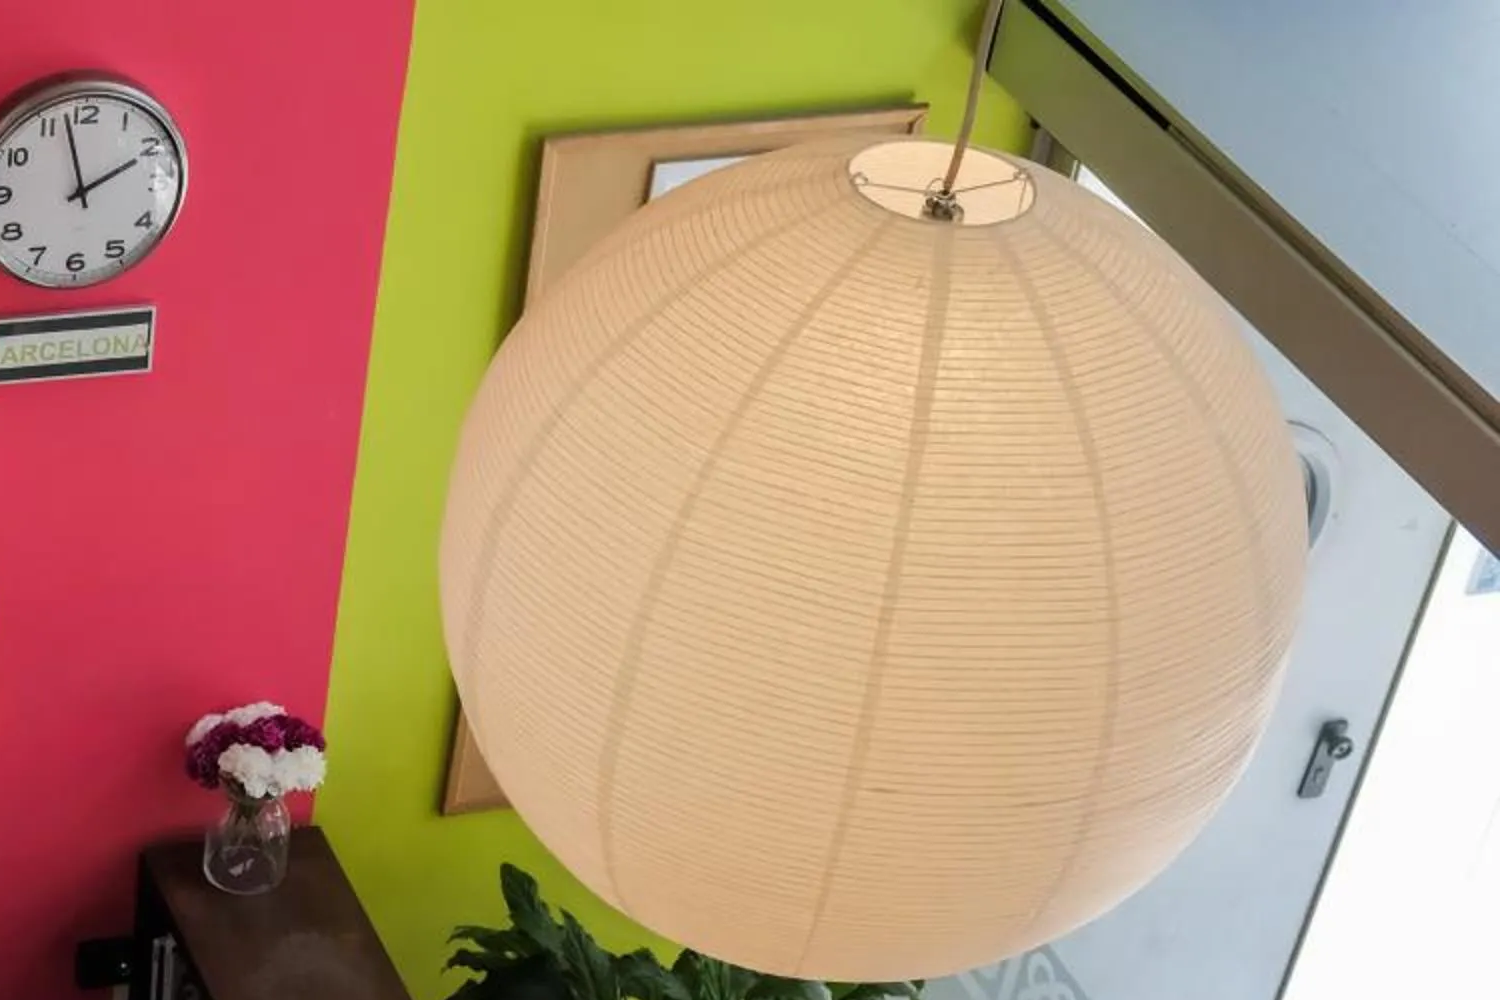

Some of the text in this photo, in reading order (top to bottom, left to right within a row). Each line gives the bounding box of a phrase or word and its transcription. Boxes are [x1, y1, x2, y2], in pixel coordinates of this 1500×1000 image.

[73, 106, 99, 125] 12
[40, 118, 55, 137] 11
[7, 148, 29, 167] 10
[134, 211, 153, 228] 4
[0, 222, 23, 241] 8
[29, 246, 47, 265] 7
[104, 240, 125, 258] 5
[65, 253, 85, 272] 6
